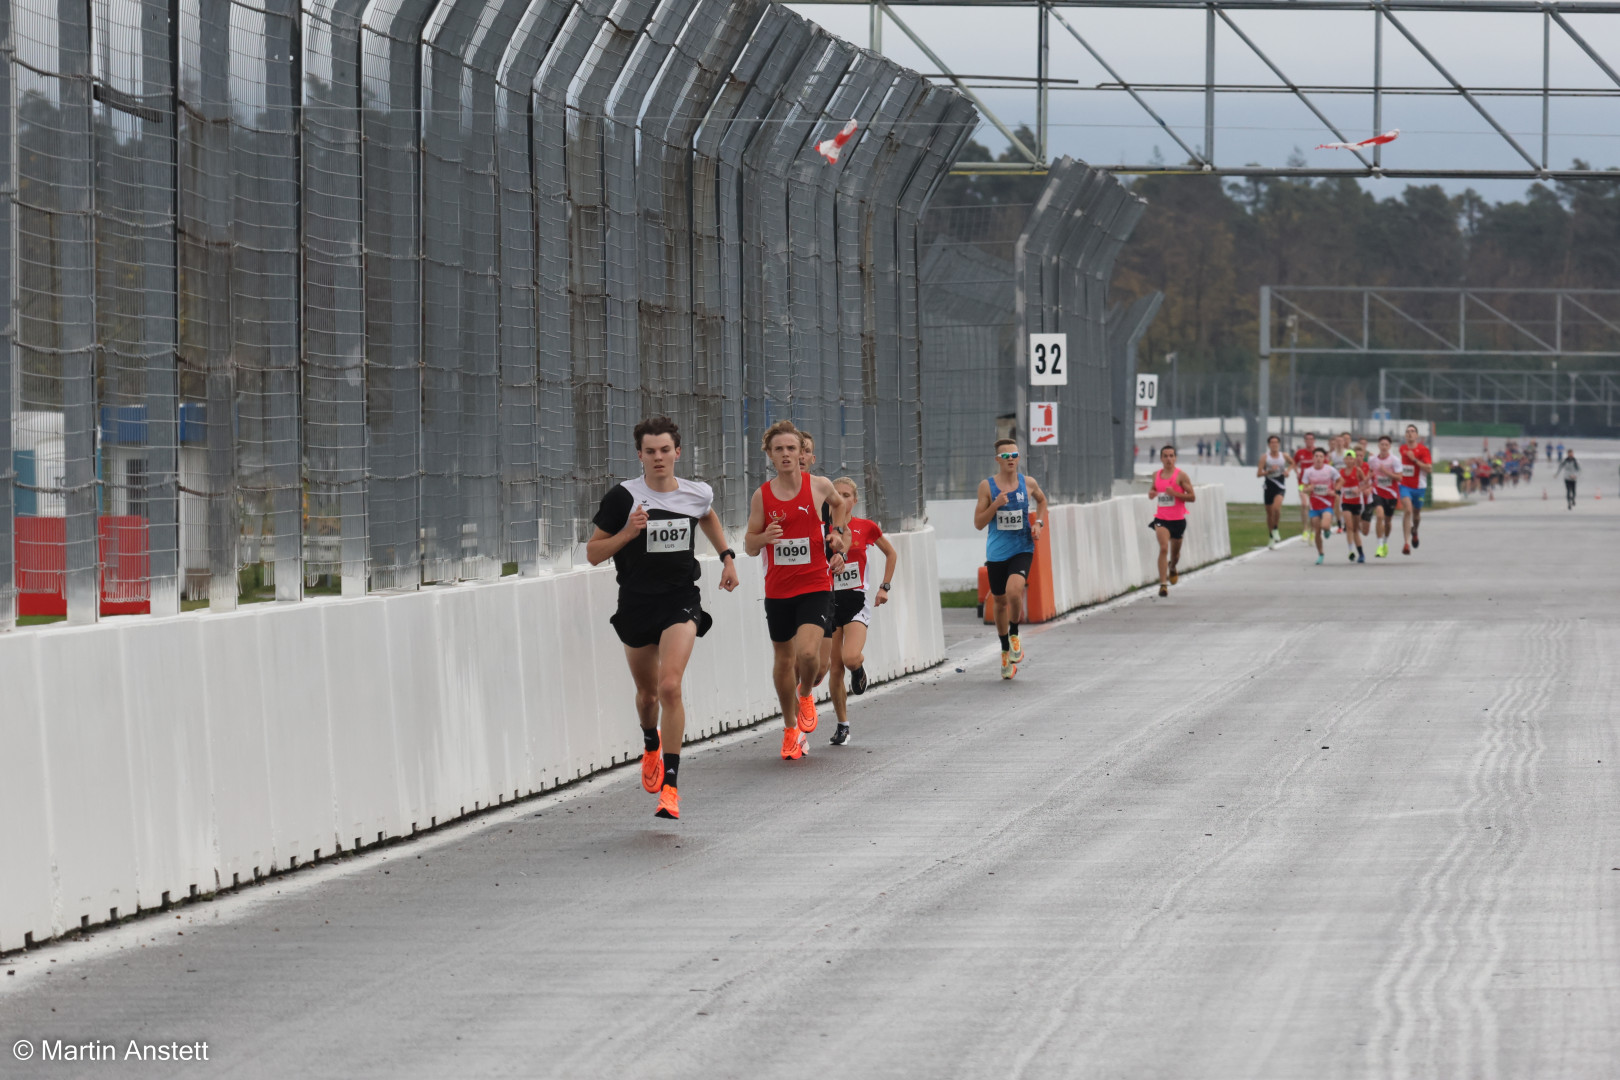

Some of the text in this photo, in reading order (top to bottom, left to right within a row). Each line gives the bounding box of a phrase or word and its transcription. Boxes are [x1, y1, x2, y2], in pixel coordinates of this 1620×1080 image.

[1035, 343, 1061, 374] 32
[1138, 381, 1154, 399] 30
[998, 515, 1022, 524] 1182
[650, 528, 688, 542] 1087
[776, 545, 807, 557] 1090
